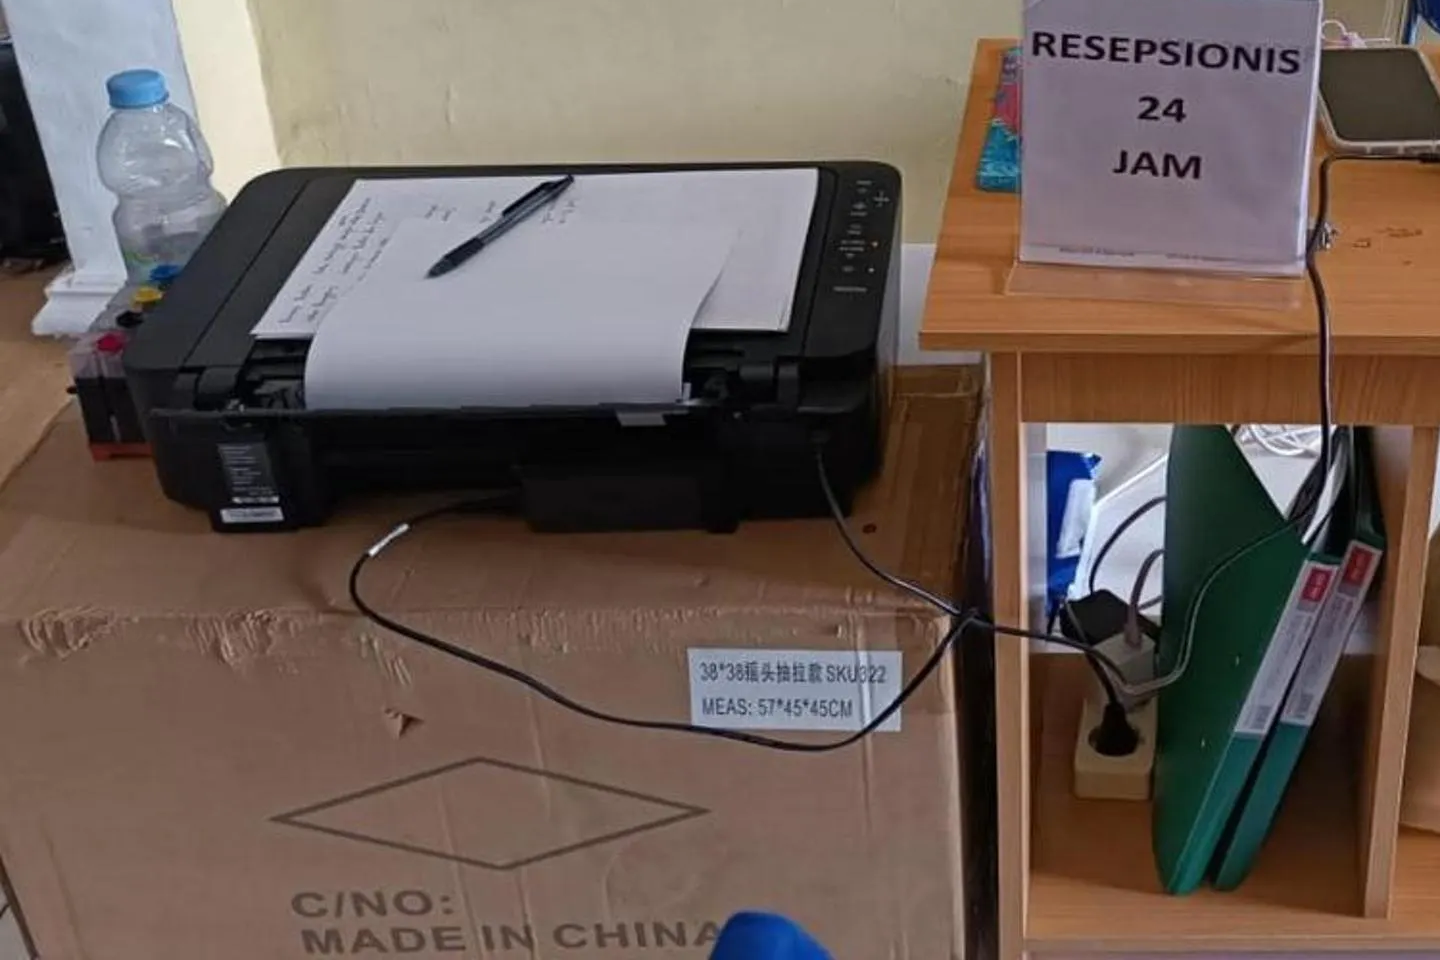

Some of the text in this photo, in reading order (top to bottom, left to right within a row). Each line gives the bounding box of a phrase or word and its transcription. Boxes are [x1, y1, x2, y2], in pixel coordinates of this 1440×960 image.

[1031, 31, 1301, 75] RESEPSIONIS
[1137, 96, 1187, 124] 24
[1113, 150, 1202, 180] JAM
[702, 698, 753, 716] MEAS:
[291, 889, 454, 918] C/NO:
[301, 926, 467, 955] MADE
[482, 924, 536, 952] IN
